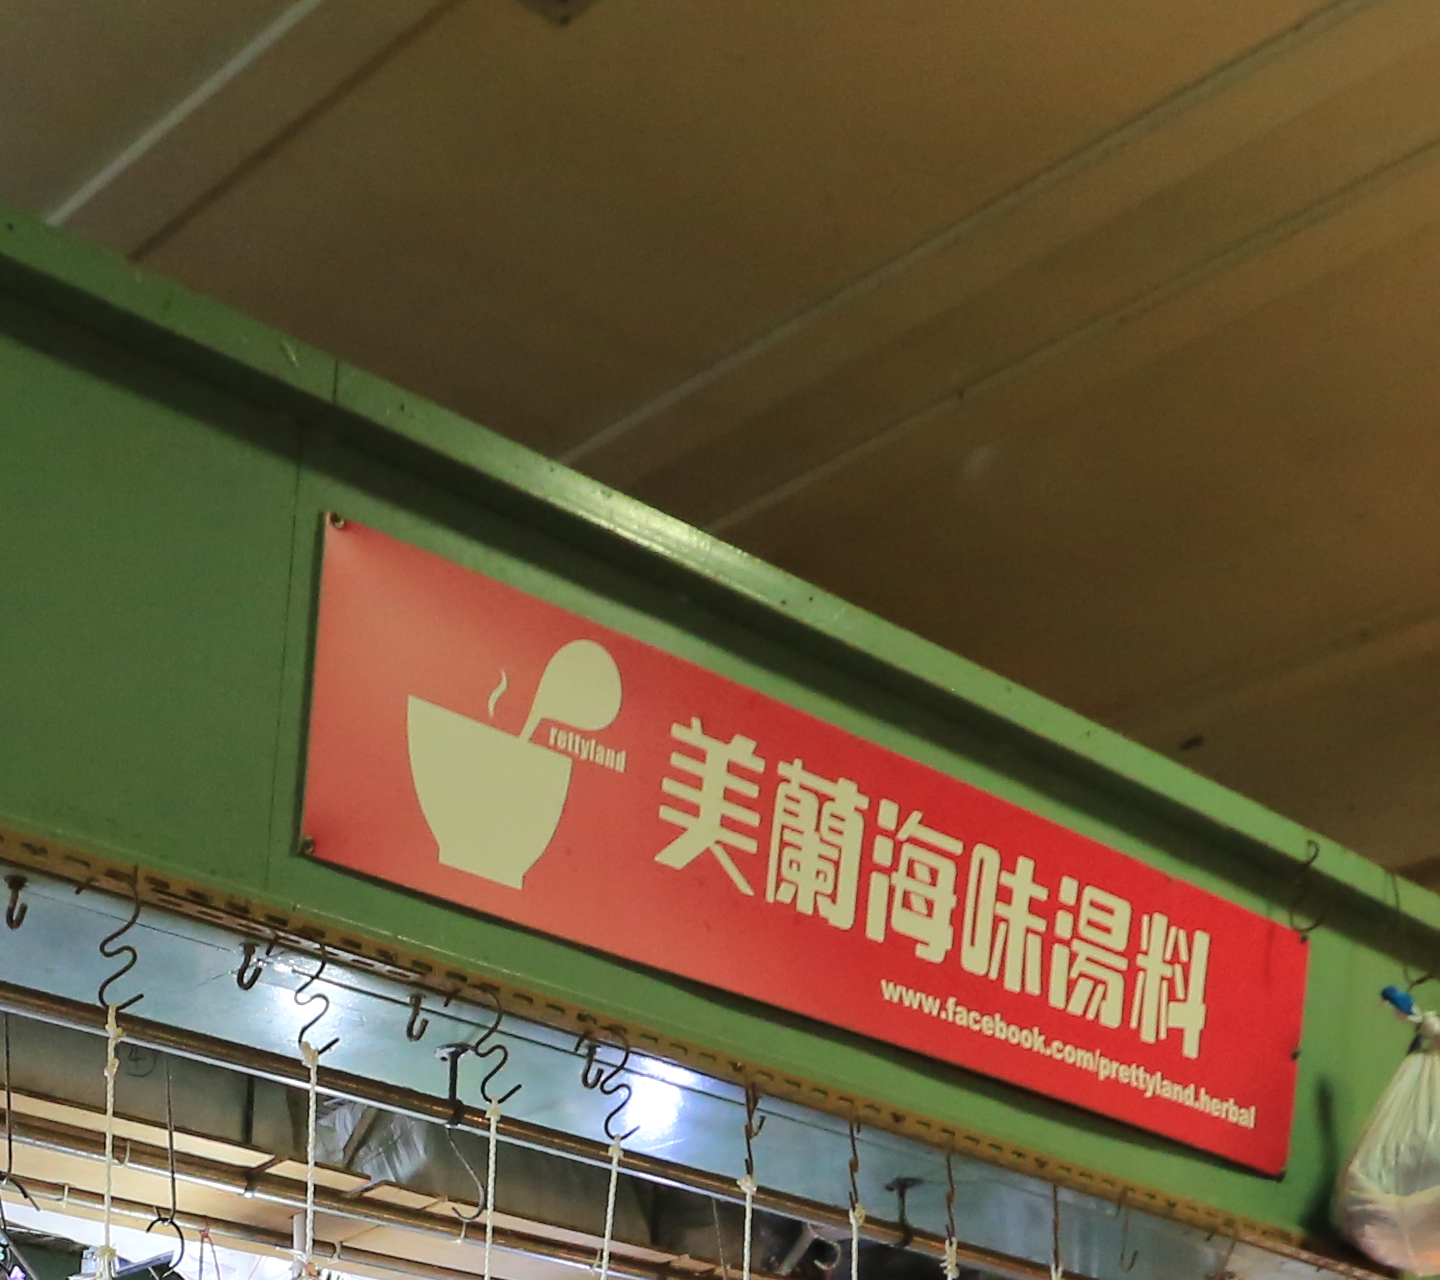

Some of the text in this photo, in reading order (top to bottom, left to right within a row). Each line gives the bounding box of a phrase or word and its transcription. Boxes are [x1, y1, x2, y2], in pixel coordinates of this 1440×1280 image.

[653, 716, 1211, 1060] 美蘭海味湯料
[881, 979, 1257, 1131] www.facebook.com/prettyland.herbal
